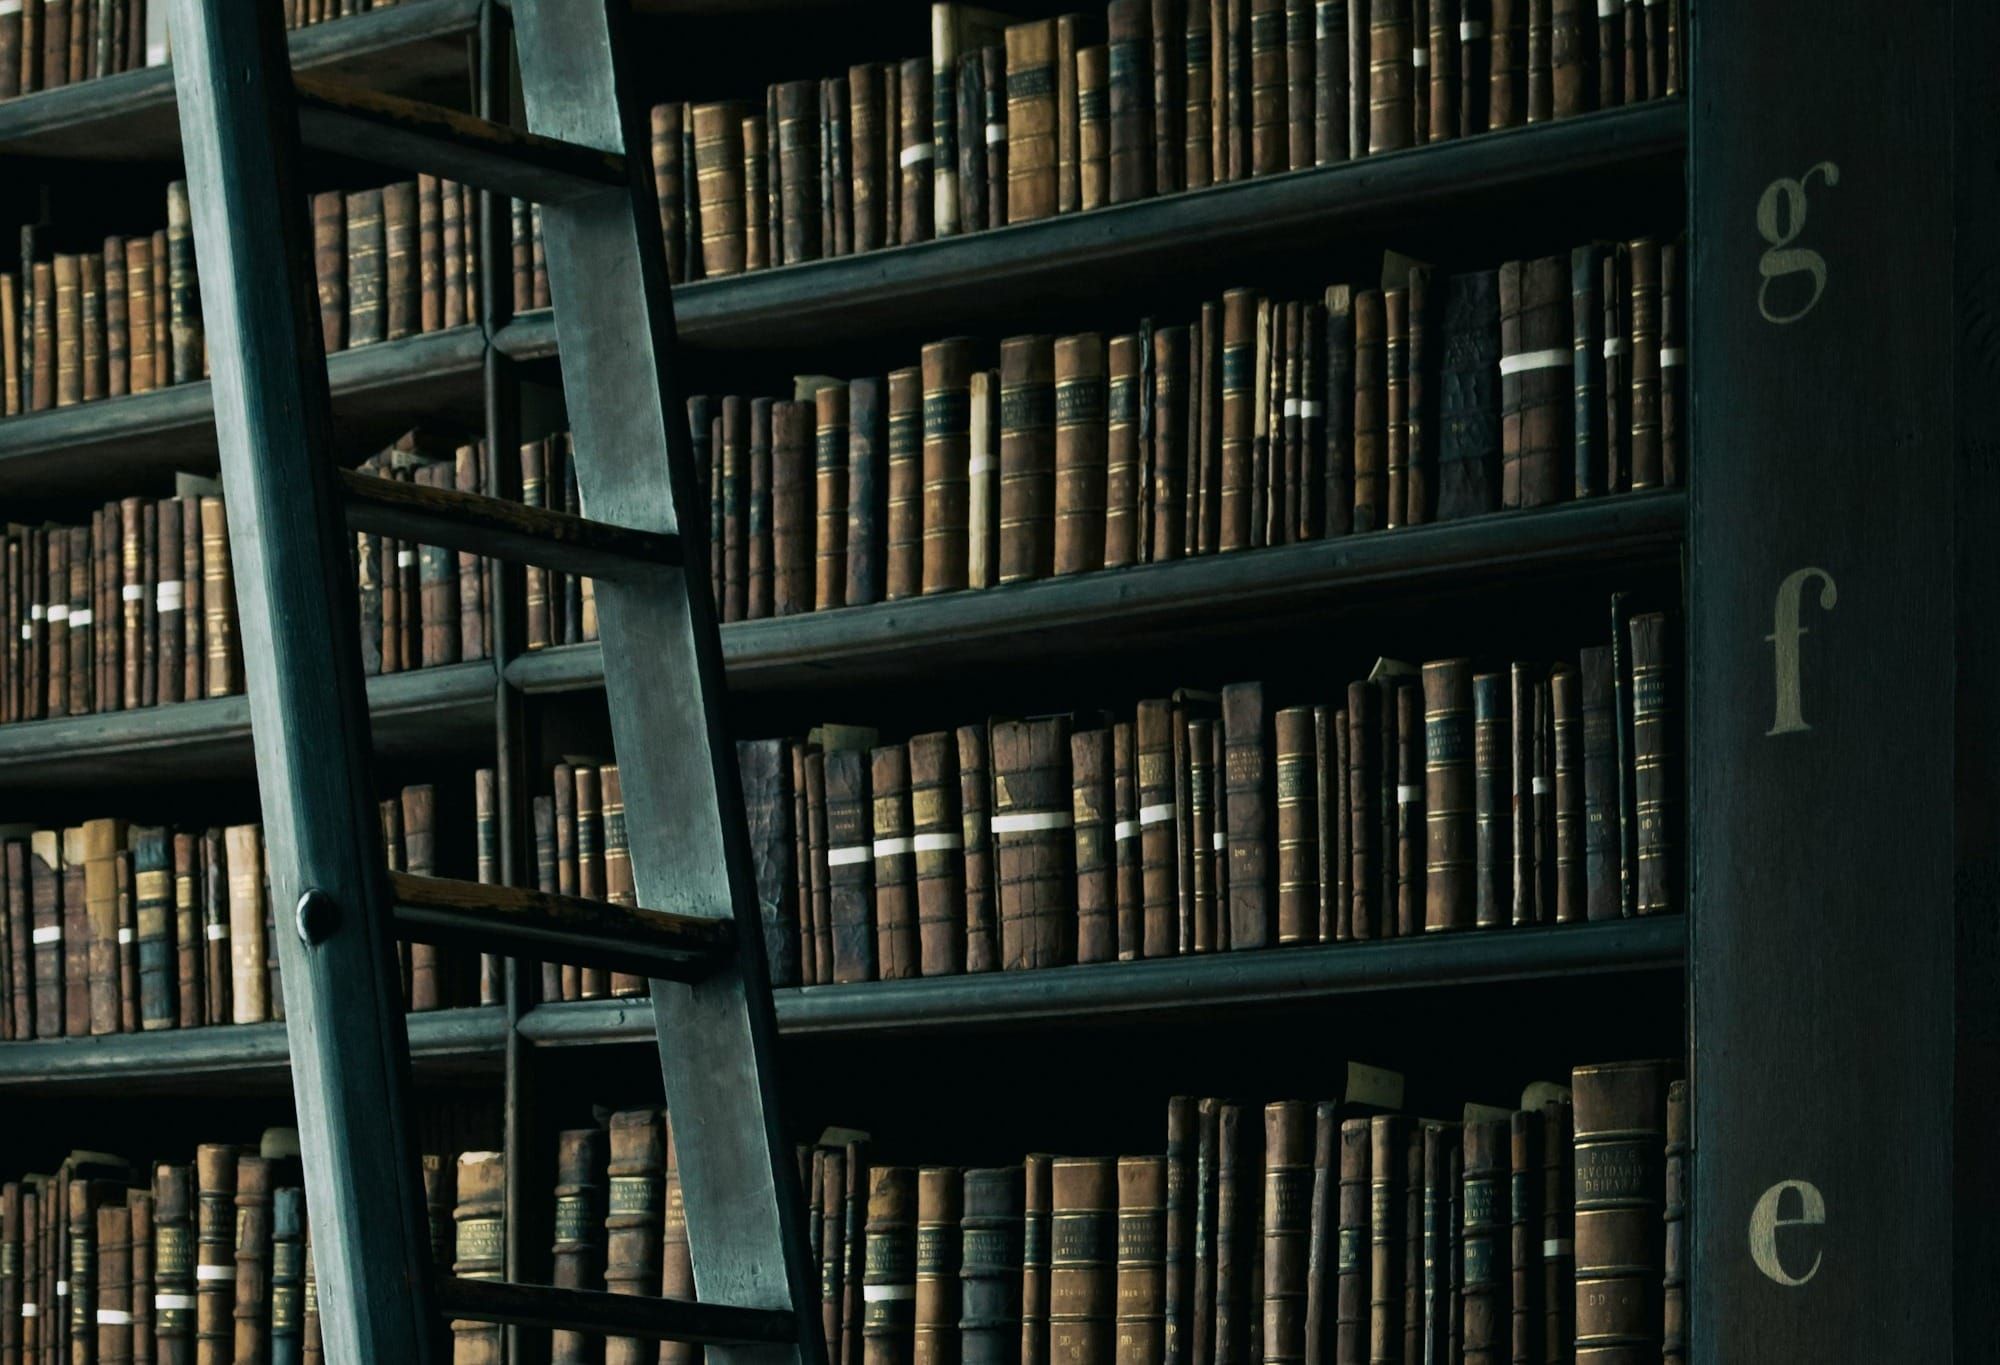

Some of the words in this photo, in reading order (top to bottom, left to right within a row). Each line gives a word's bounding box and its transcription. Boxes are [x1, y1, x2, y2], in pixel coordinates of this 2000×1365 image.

[1756, 160, 1840, 324] g
[1764, 566, 1838, 736] f
[1748, 1178, 1826, 1287] e
